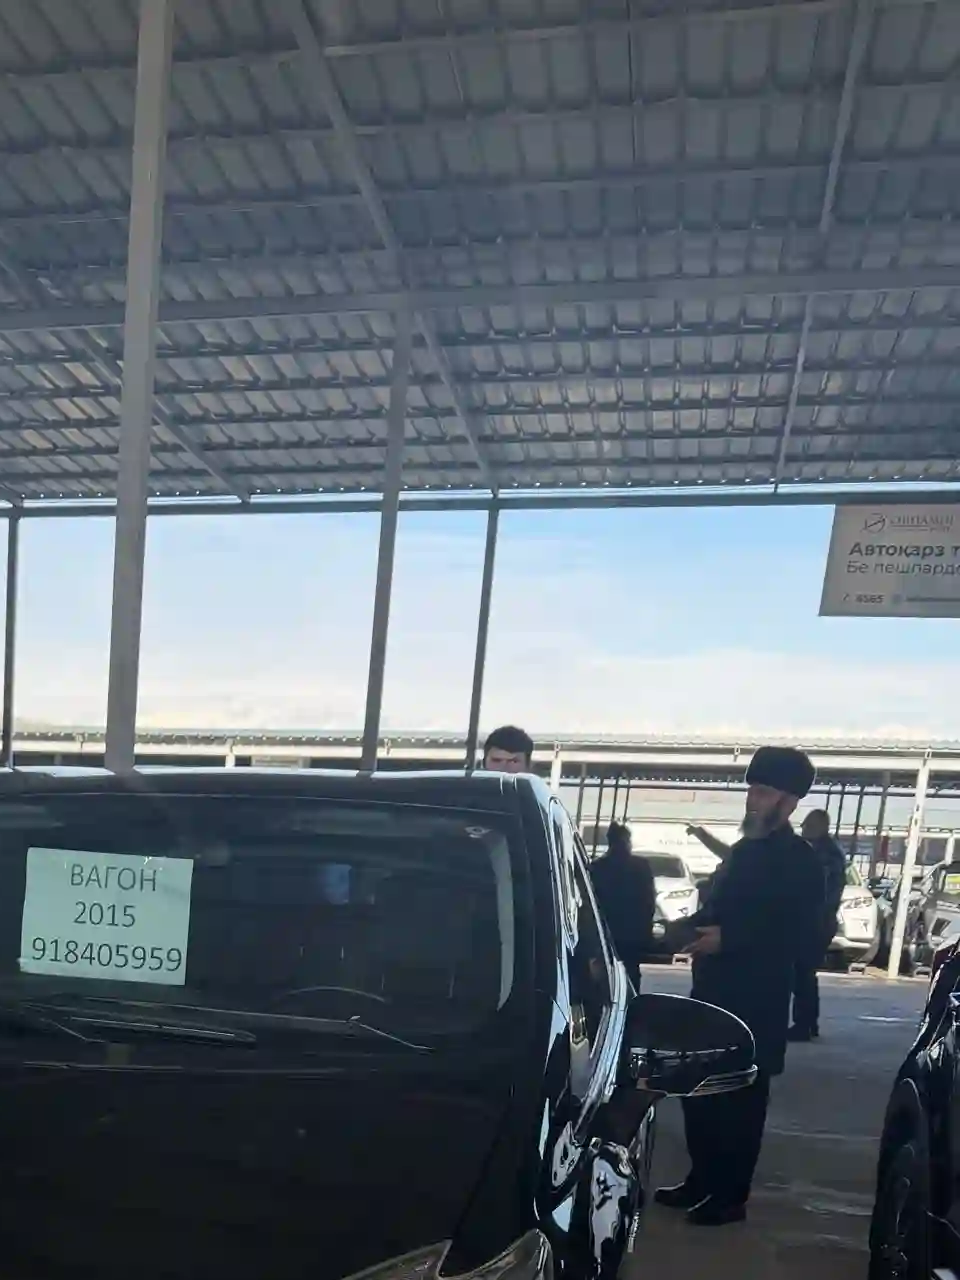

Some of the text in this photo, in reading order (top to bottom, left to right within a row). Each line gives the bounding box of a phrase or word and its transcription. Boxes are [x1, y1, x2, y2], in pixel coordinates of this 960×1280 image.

[847, 560, 869, 574] Бе
[70, 863, 157, 892] ВАГОН
[73, 900, 136, 928] 2015
[31, 936, 183, 972] 918405959
